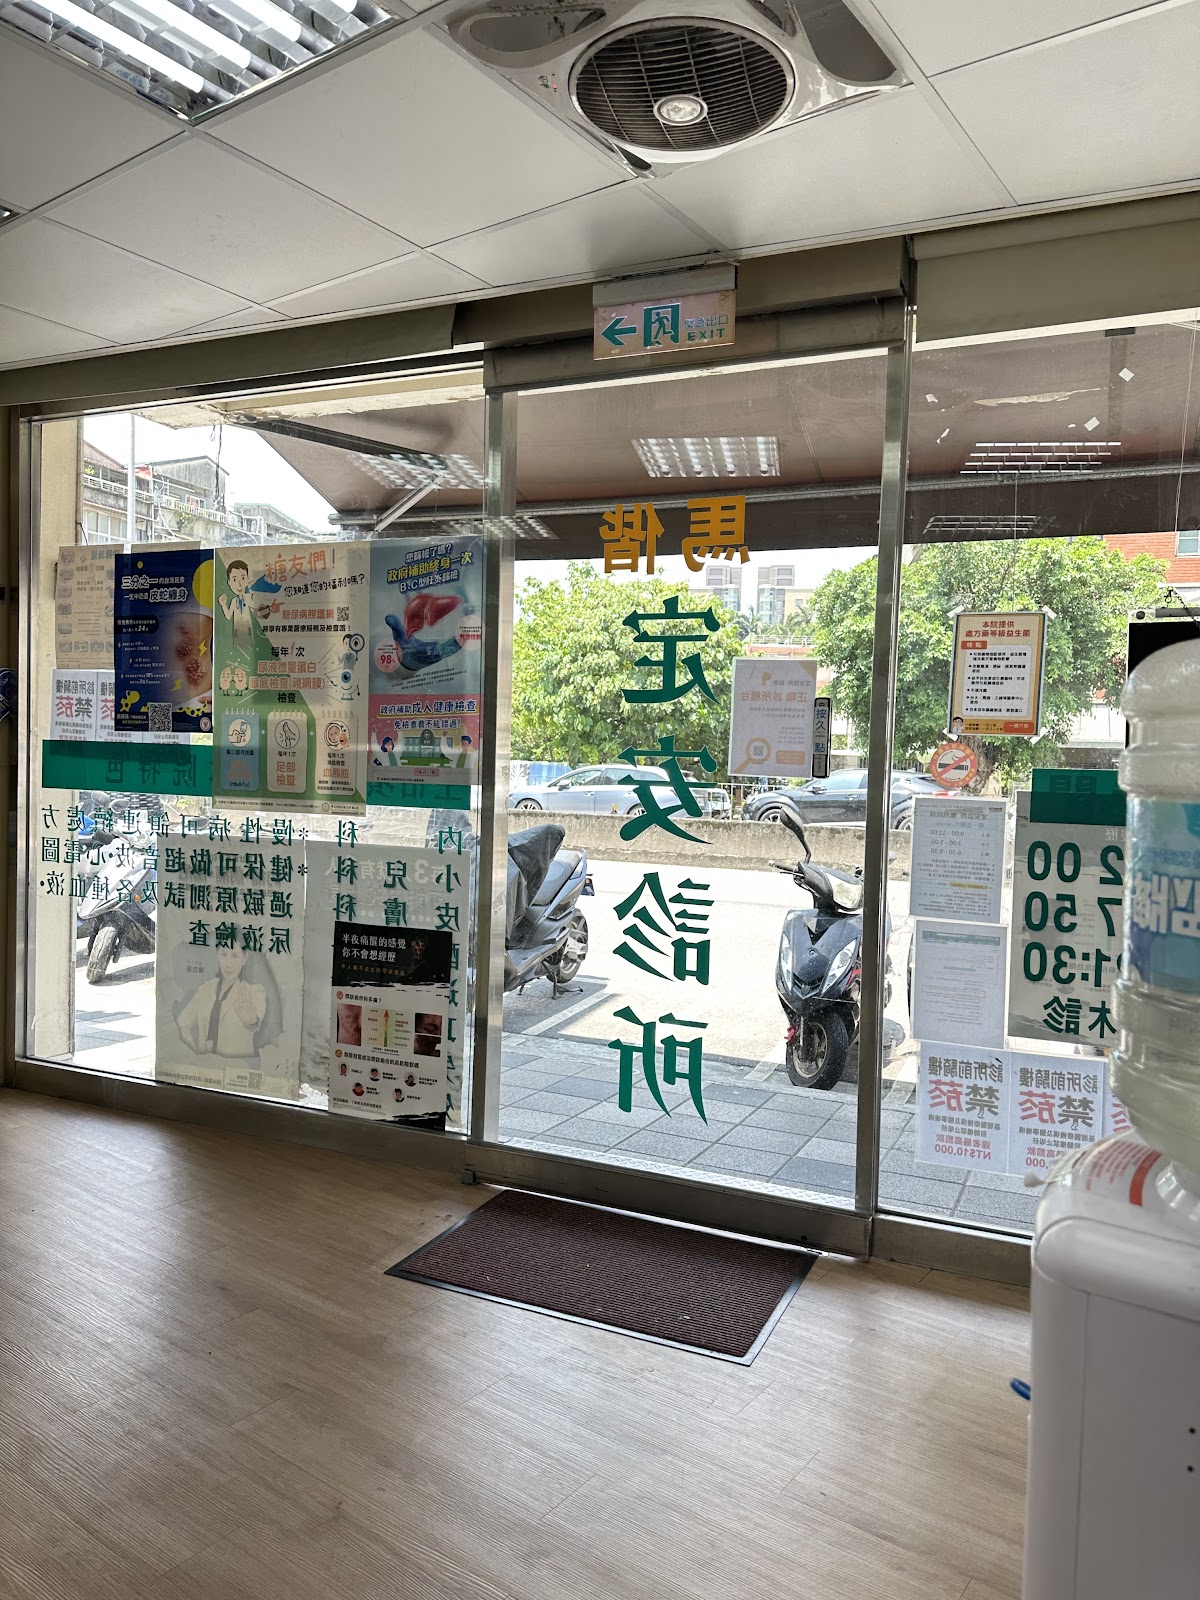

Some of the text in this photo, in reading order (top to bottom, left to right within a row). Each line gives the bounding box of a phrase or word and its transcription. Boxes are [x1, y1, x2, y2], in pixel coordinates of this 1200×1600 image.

[684, 314, 729, 330] 緊急出口
[687, 327, 726, 341] EXIT
[387, 551, 472, 582] 政府補助終身一次
[283, 573, 365, 597] 您知道您的福利嗎?
[282, 608, 335, 620] 糖尿病照護網
[981, 620, 1015, 629] 本院提供
[965, 629, 1031, 638] 處方藥等級益生菌
[271, 641, 305, 657] 每年1次
[258, 661, 317, 674] 尿液微量蛋白
[249, 676, 326, 690] 眼底檢查(視網膜)
[277, 692, 297, 704] 檢查
[380, 699, 476, 714] 政府補助成人健康檢查
[394, 718, 461, 730] 免檢查費不能錯過!
[276, 761, 296, 773] 足部
[322, 768, 350, 779] 血脂肪
[276, 774, 296, 787] 檢查
[341, 933, 407, 949] 半夜痛醒的感覺
[341, 946, 397, 963] 你不會想經歷
